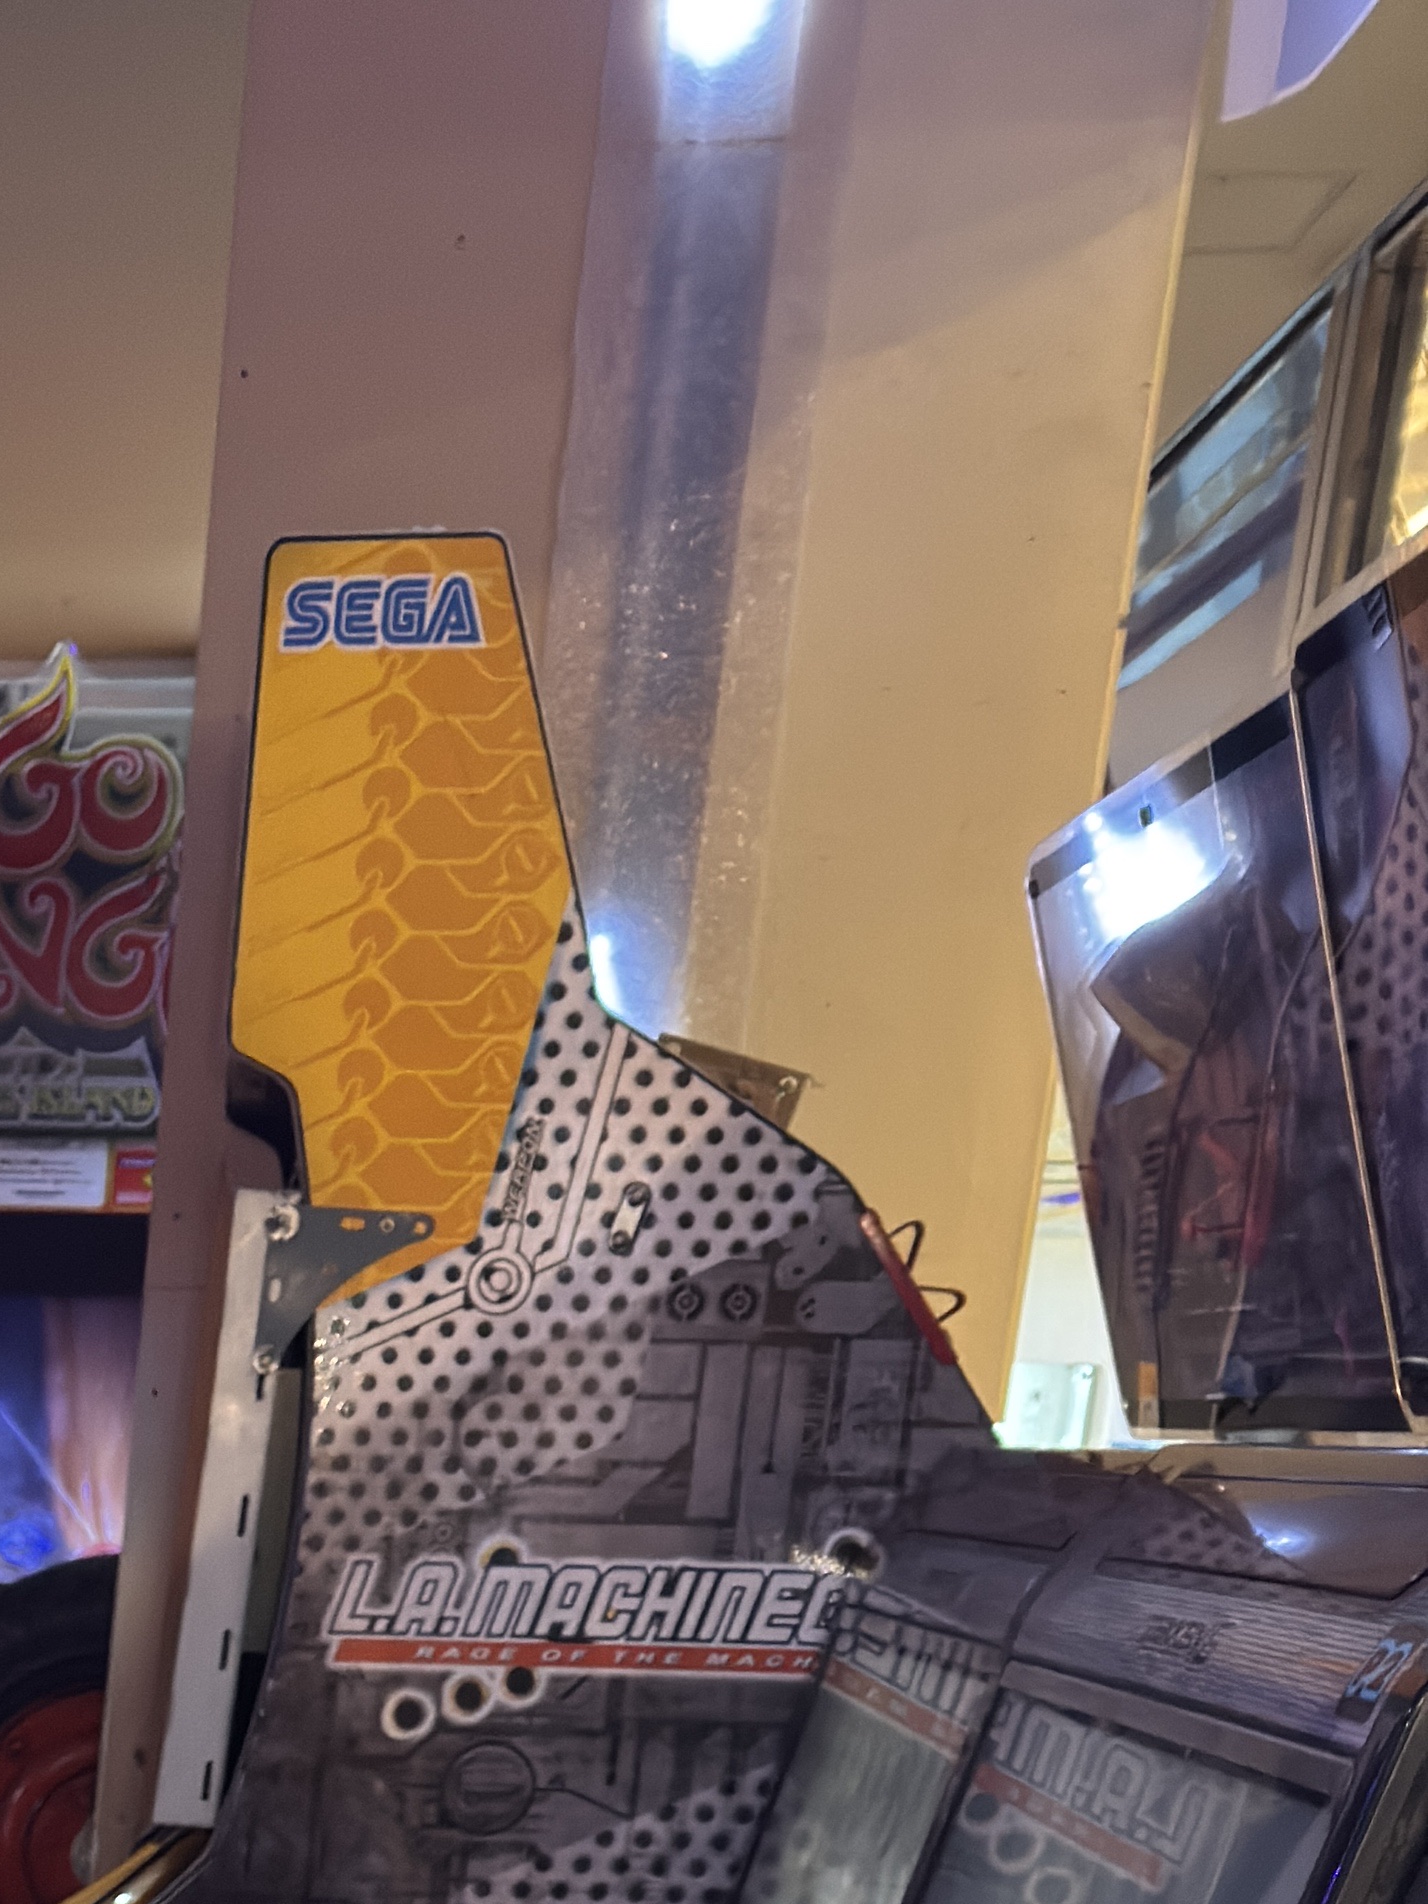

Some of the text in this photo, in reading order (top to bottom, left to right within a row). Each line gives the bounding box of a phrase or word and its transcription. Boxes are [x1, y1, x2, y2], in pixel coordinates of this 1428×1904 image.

[281, 575, 484, 650] SEGA
[412, 1643, 519, 1663] RAGE
[540, 1647, 587, 1665] OF
[611, 1649, 683, 1667] THE
